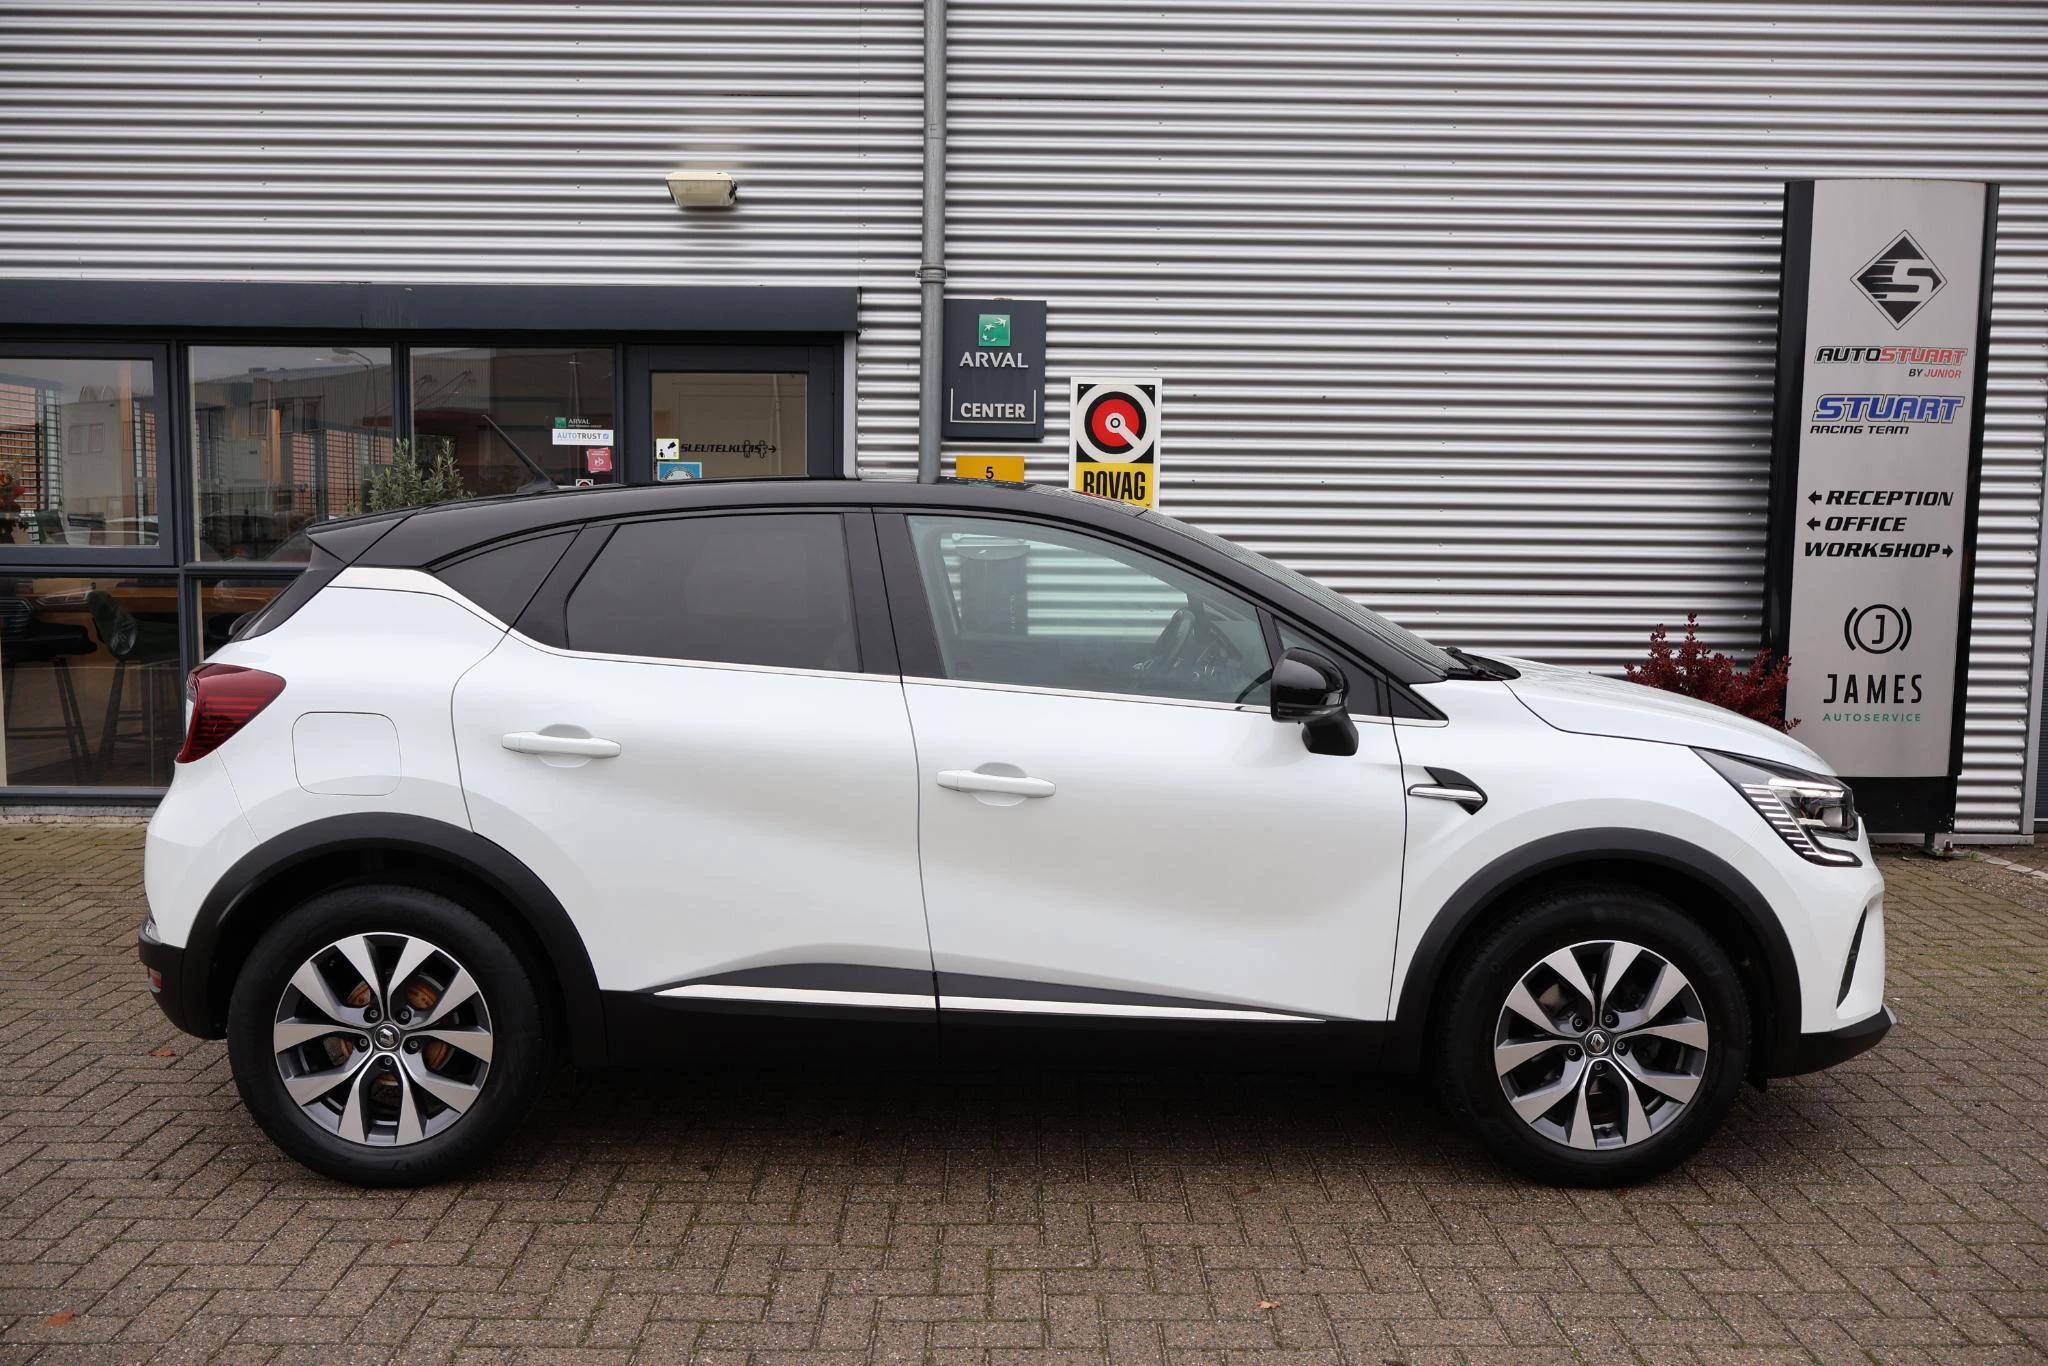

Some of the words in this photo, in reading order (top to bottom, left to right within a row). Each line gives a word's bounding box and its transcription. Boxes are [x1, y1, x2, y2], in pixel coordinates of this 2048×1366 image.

[959, 352, 1028, 369] ARVAL
[1815, 346, 1968, 365] AUTOSTUART
[1908, 368, 1923, 378] BY
[1924, 369, 1962, 379] JUNIOR
[960, 402, 1025, 418] CENTER
[1813, 394, 1965, 423] STUART
[557, 432, 602, 440] AUTOTRUST
[1810, 425, 1863, 435] RACING
[1868, 425, 1910, 435] TEAM
[985, 466, 995, 480] 5
[1825, 490, 1954, 506] RECEPTION
[1824, 516, 1907, 532] OFFICE
[1804, 542, 1941, 558] WORKSHOP
[1823, 673, 1923, 704] JAMES
[1823, 713, 1922, 722] AUTOSERVICE
